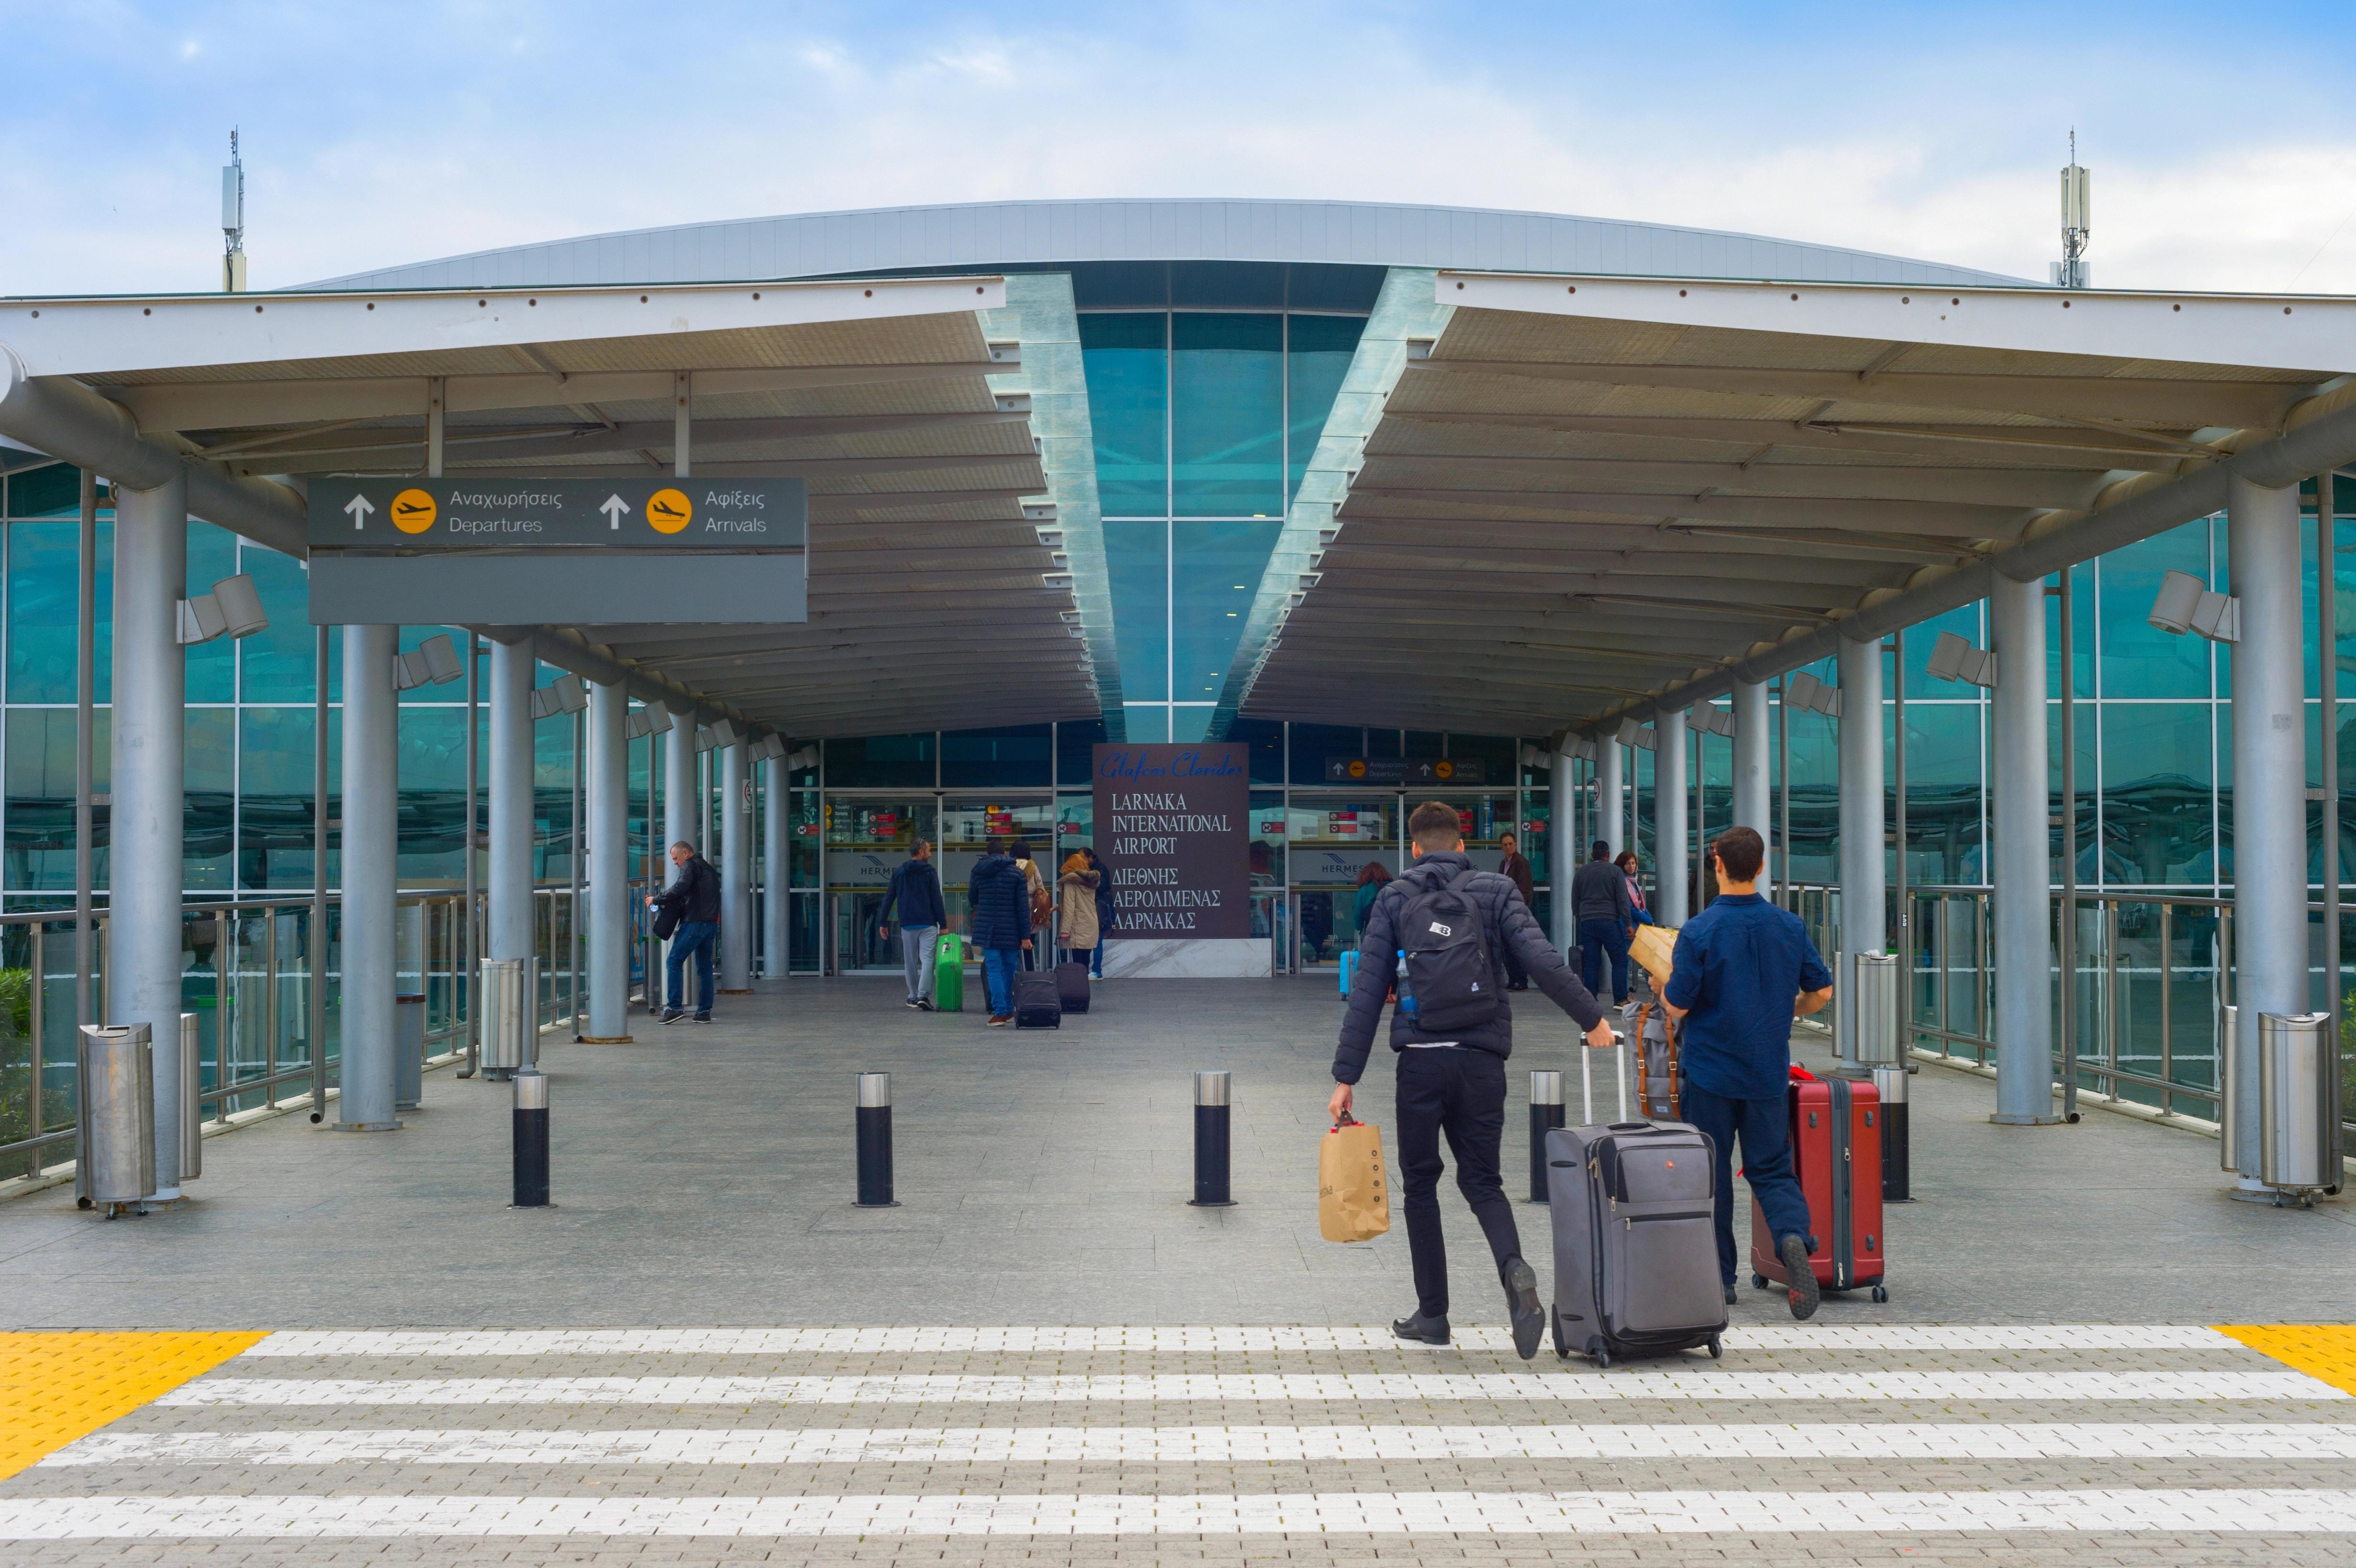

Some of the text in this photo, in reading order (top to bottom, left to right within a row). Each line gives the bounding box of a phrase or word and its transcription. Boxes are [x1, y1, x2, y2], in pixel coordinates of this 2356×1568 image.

[450, 490, 563, 509] Αναχωρήσεις
[705, 490, 765, 509] Αφίξεις
[450, 517, 542, 535] Departures
[705, 517, 766, 532] Arrivals
[1101, 751, 1242, 783] Glafcos Clerides
[1112, 793, 1187, 810] LARNAKA
[1112, 815, 1232, 832] INTERNATIONAL
[1113, 837, 1178, 854] AIRPORT
[861, 868, 895, 878] HERME
[1112, 868, 1178, 885] ΔΙΕΘΝΗΣ
[1322, 865, 1364, 875] HERMES
[1113, 890, 1221, 907] ΑΕΡΟΛΙΜΕΝΑΣ
[1114, 912, 1196, 929] ΛΑΡΝΑΚΑΣ
